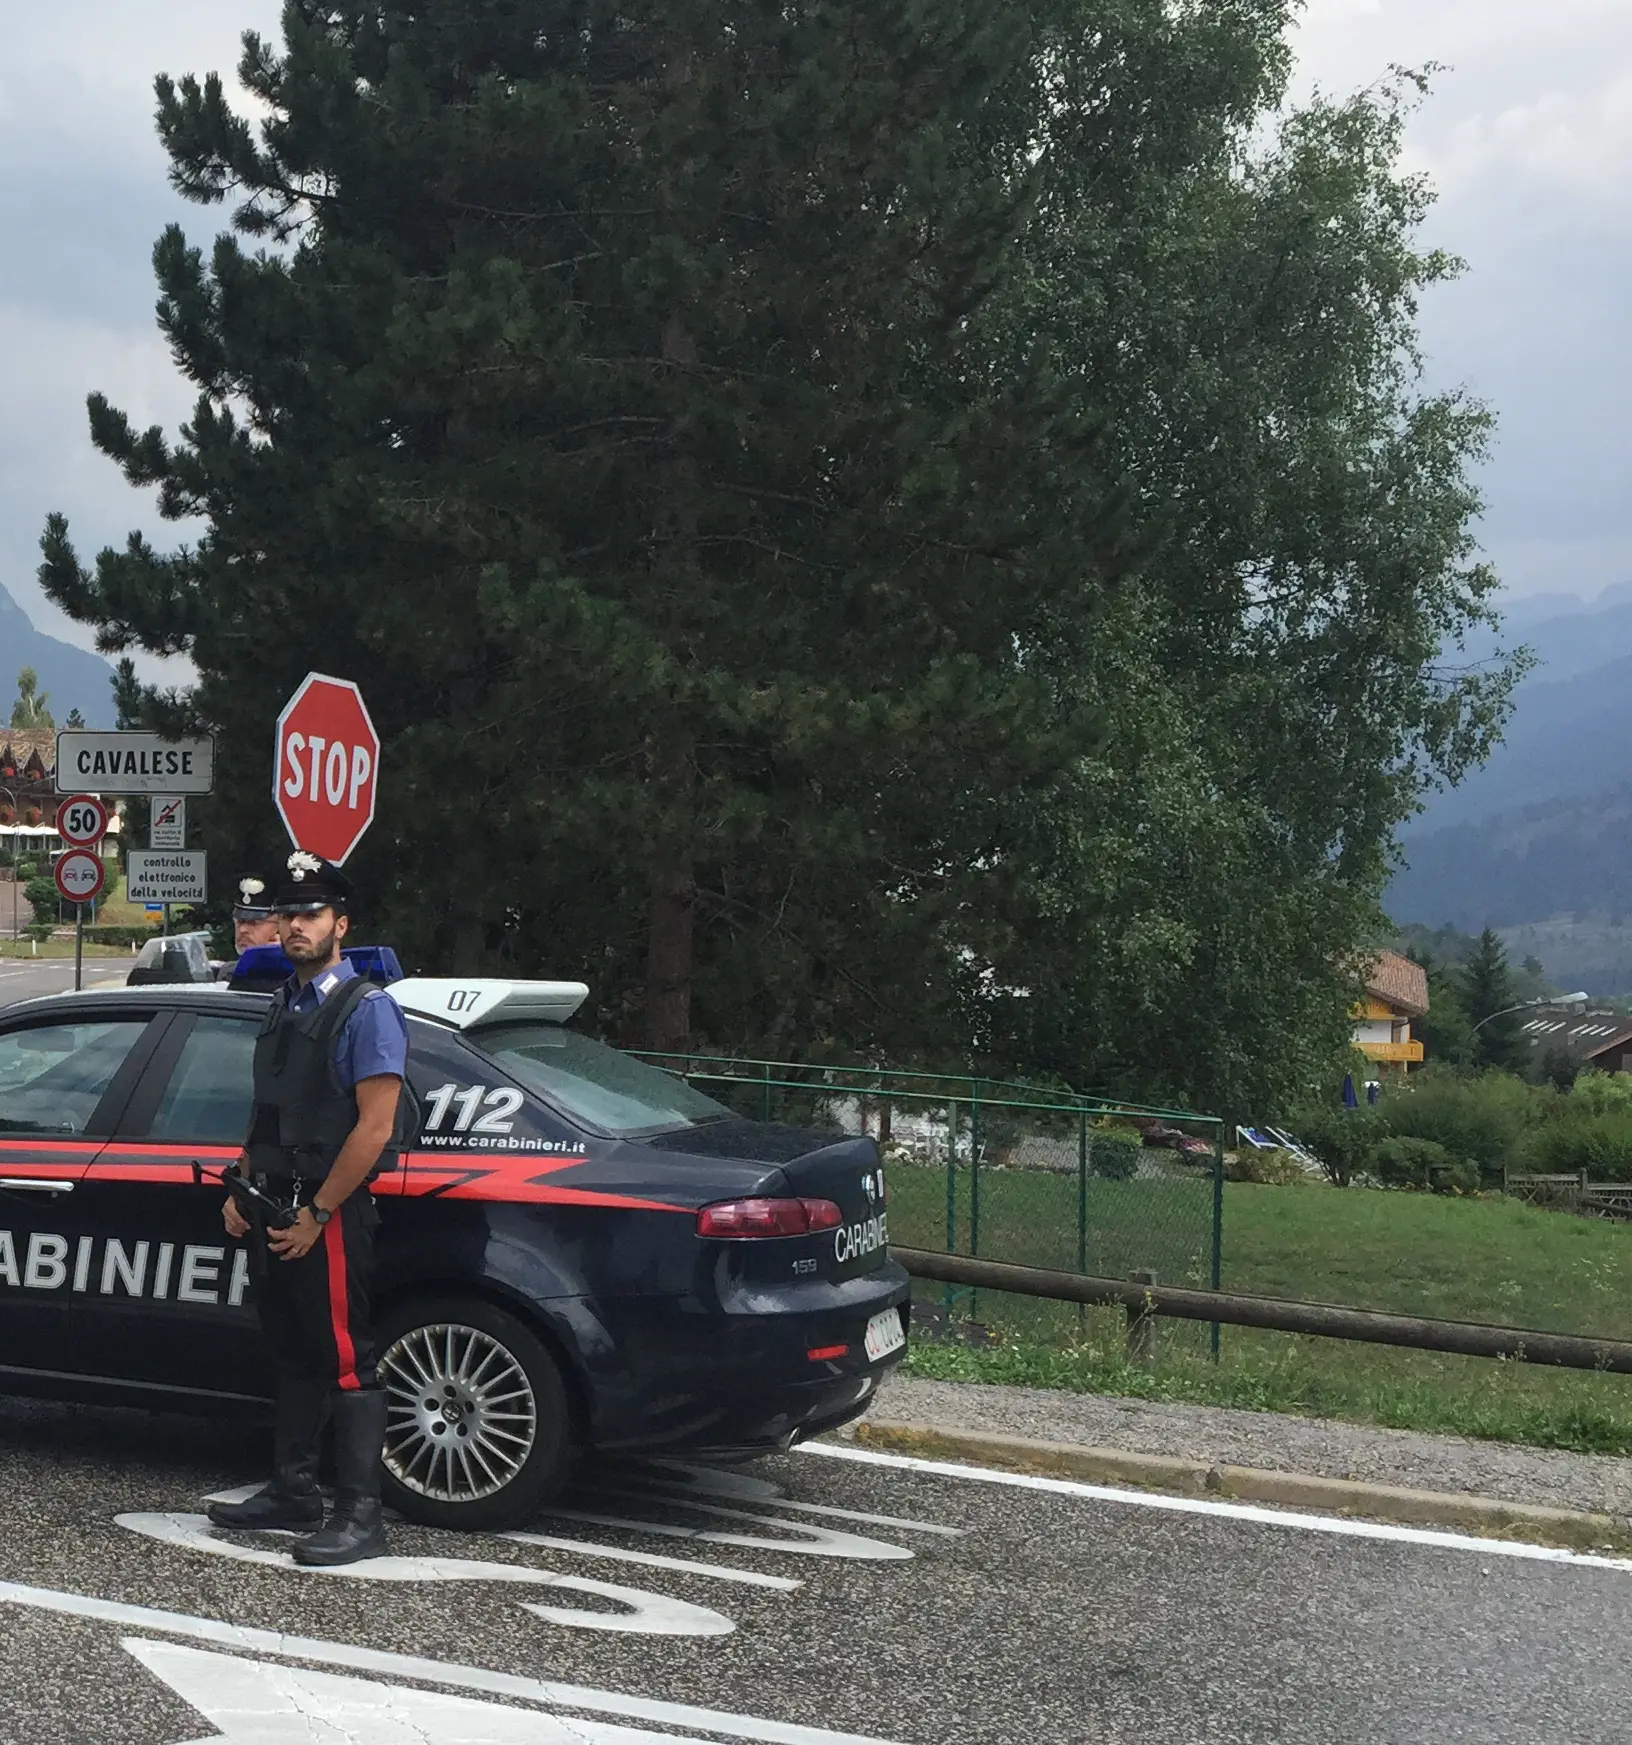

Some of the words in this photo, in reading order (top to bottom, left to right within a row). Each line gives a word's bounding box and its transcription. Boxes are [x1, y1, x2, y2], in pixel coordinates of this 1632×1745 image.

[76, 749, 194, 776] CAVALESE
[283, 731, 371, 810] STOP
[68, 807, 97, 834] 50
[142, 856, 191, 868] controllo
[138, 871, 196, 883] elettronico
[130, 885, 158, 898] della
[446, 989, 482, 1013] 07
[423, 1083, 524, 1133] 112
[420, 1133, 586, 1154] www.carabinieri.it
